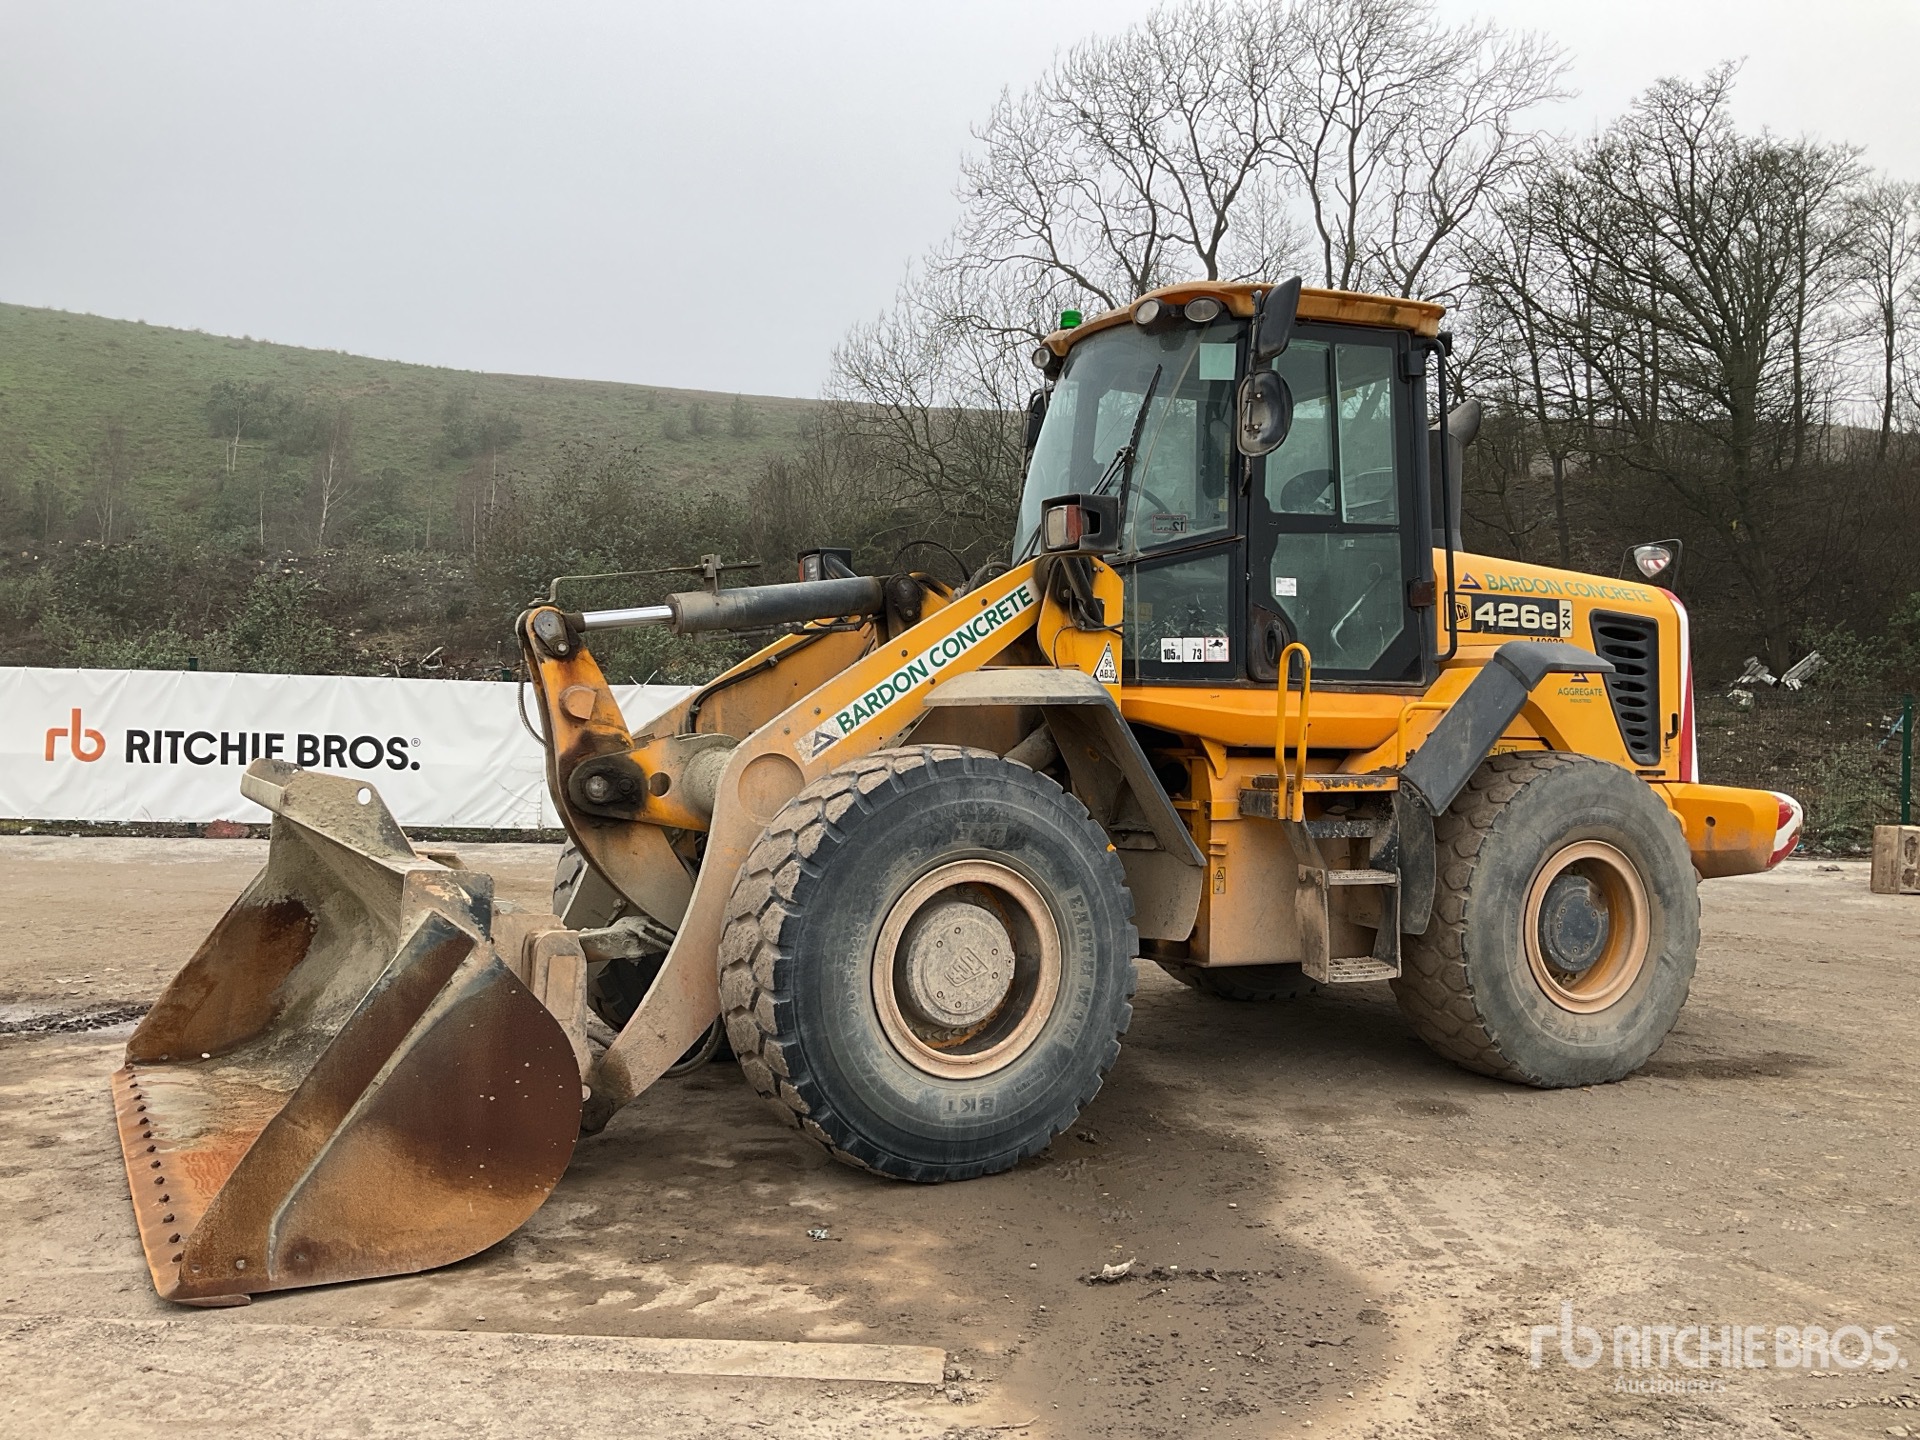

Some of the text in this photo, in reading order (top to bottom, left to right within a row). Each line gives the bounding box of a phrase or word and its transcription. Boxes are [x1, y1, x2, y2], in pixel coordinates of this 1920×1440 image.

[1484, 574, 1653, 603] BARDON CONCRETE
[1455, 603, 1470, 621] CB
[1474, 602, 1558, 630] 426e
[835, 585, 1035, 734] BARDON CONCRETE
[1163, 648, 1176, 660] 105
[1192, 648, 1202, 660] 73
[1557, 687, 1603, 697] AGGREGATE
[45, 708, 107, 763] rb
[125, 729, 285, 766] RITCHIE
